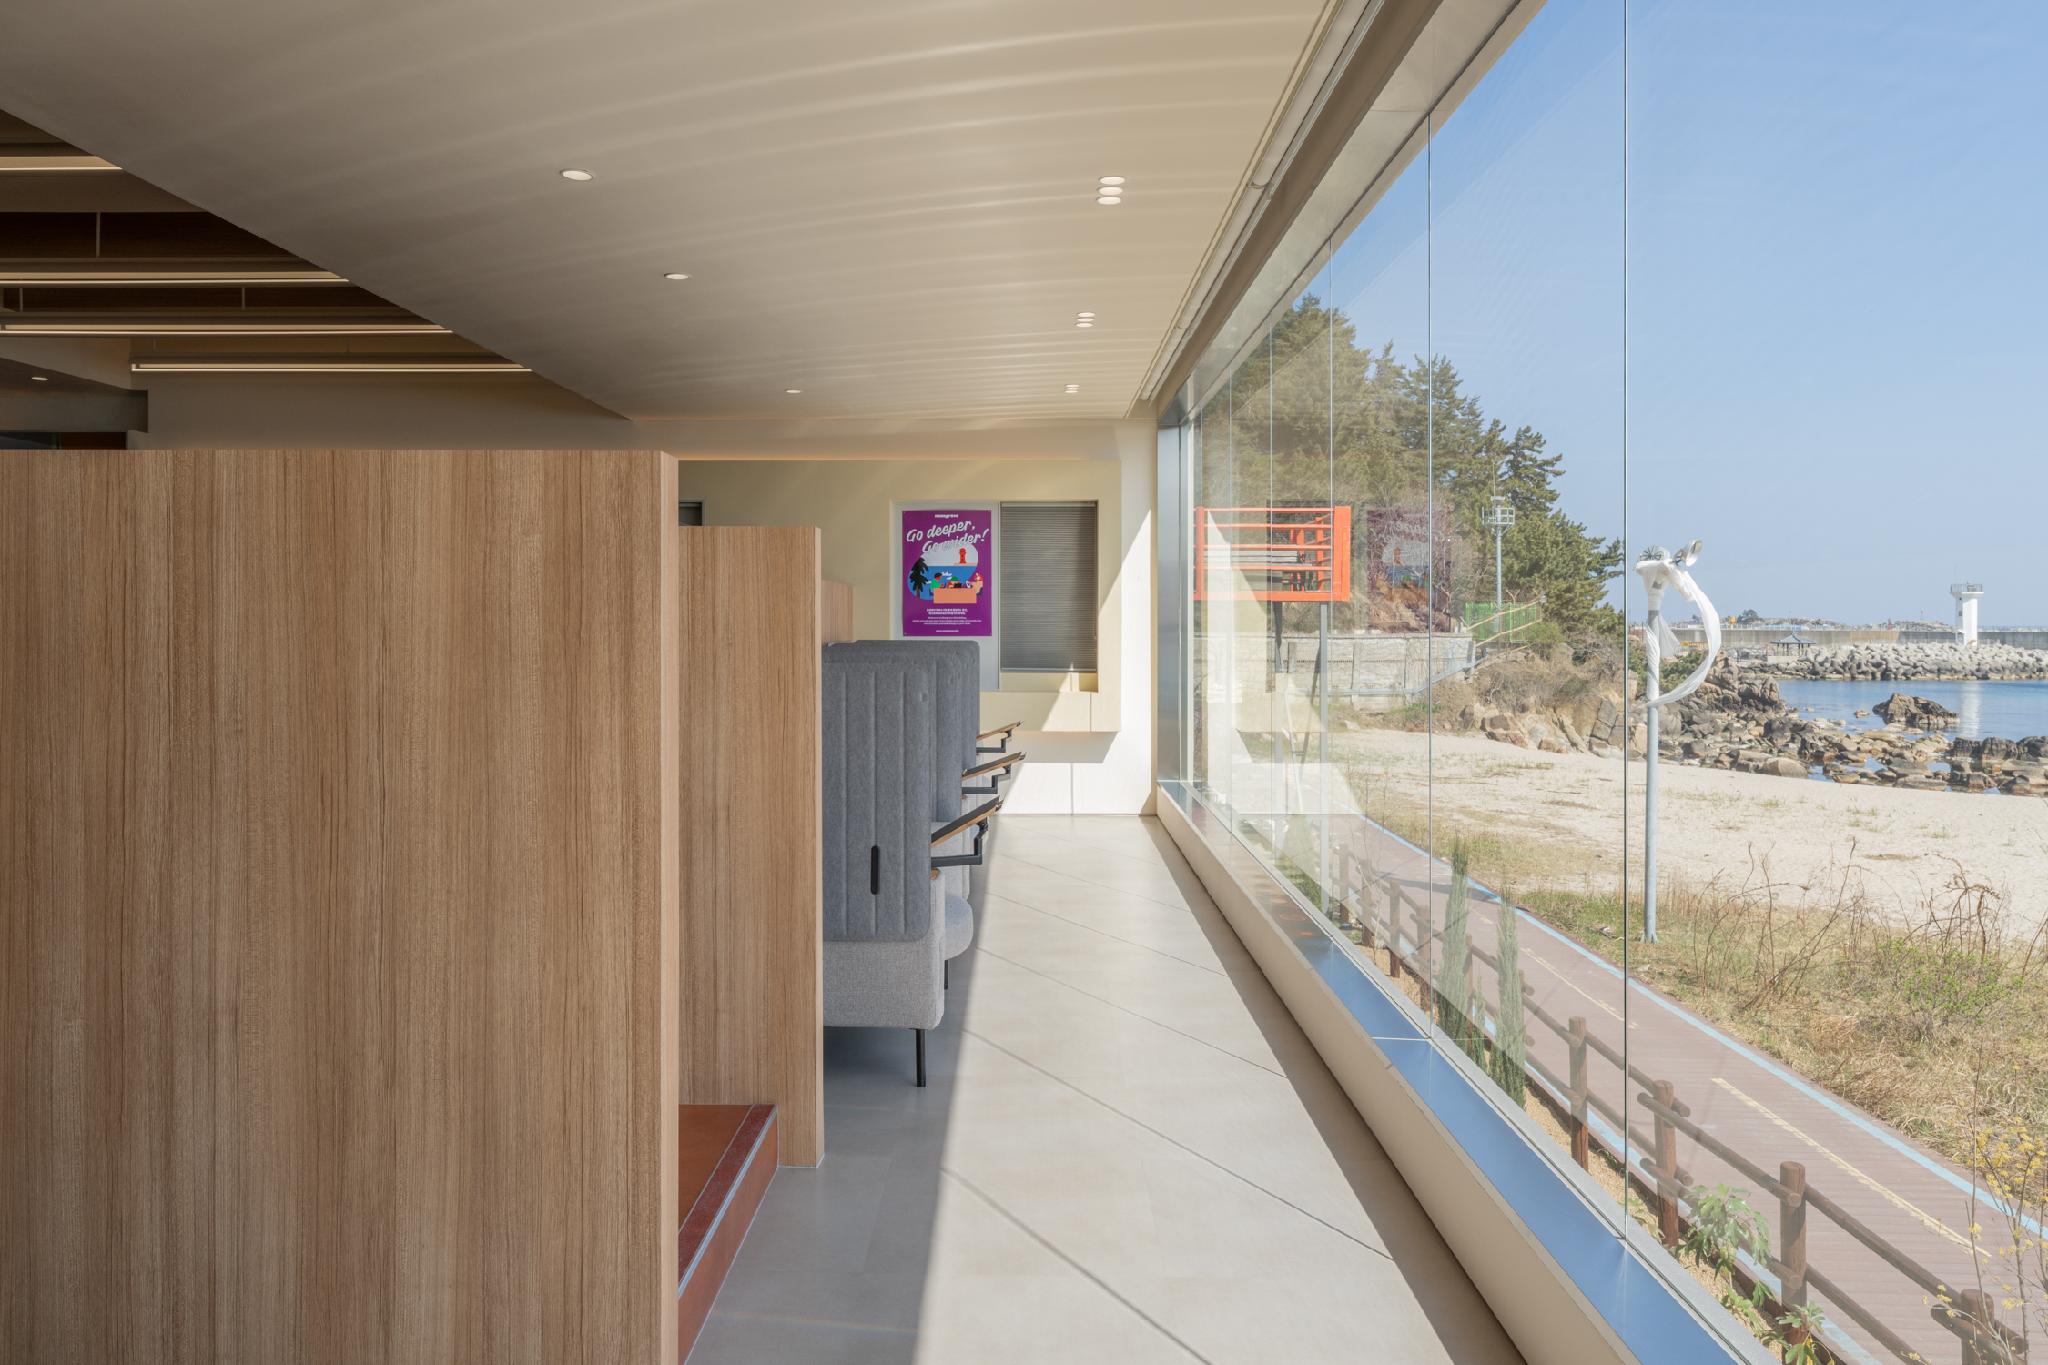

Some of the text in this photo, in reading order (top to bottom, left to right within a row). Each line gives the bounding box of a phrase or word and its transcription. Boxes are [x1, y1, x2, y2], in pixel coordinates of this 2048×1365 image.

[906, 520, 975, 542] Go deeper,
[922, 540, 938, 552] Go
